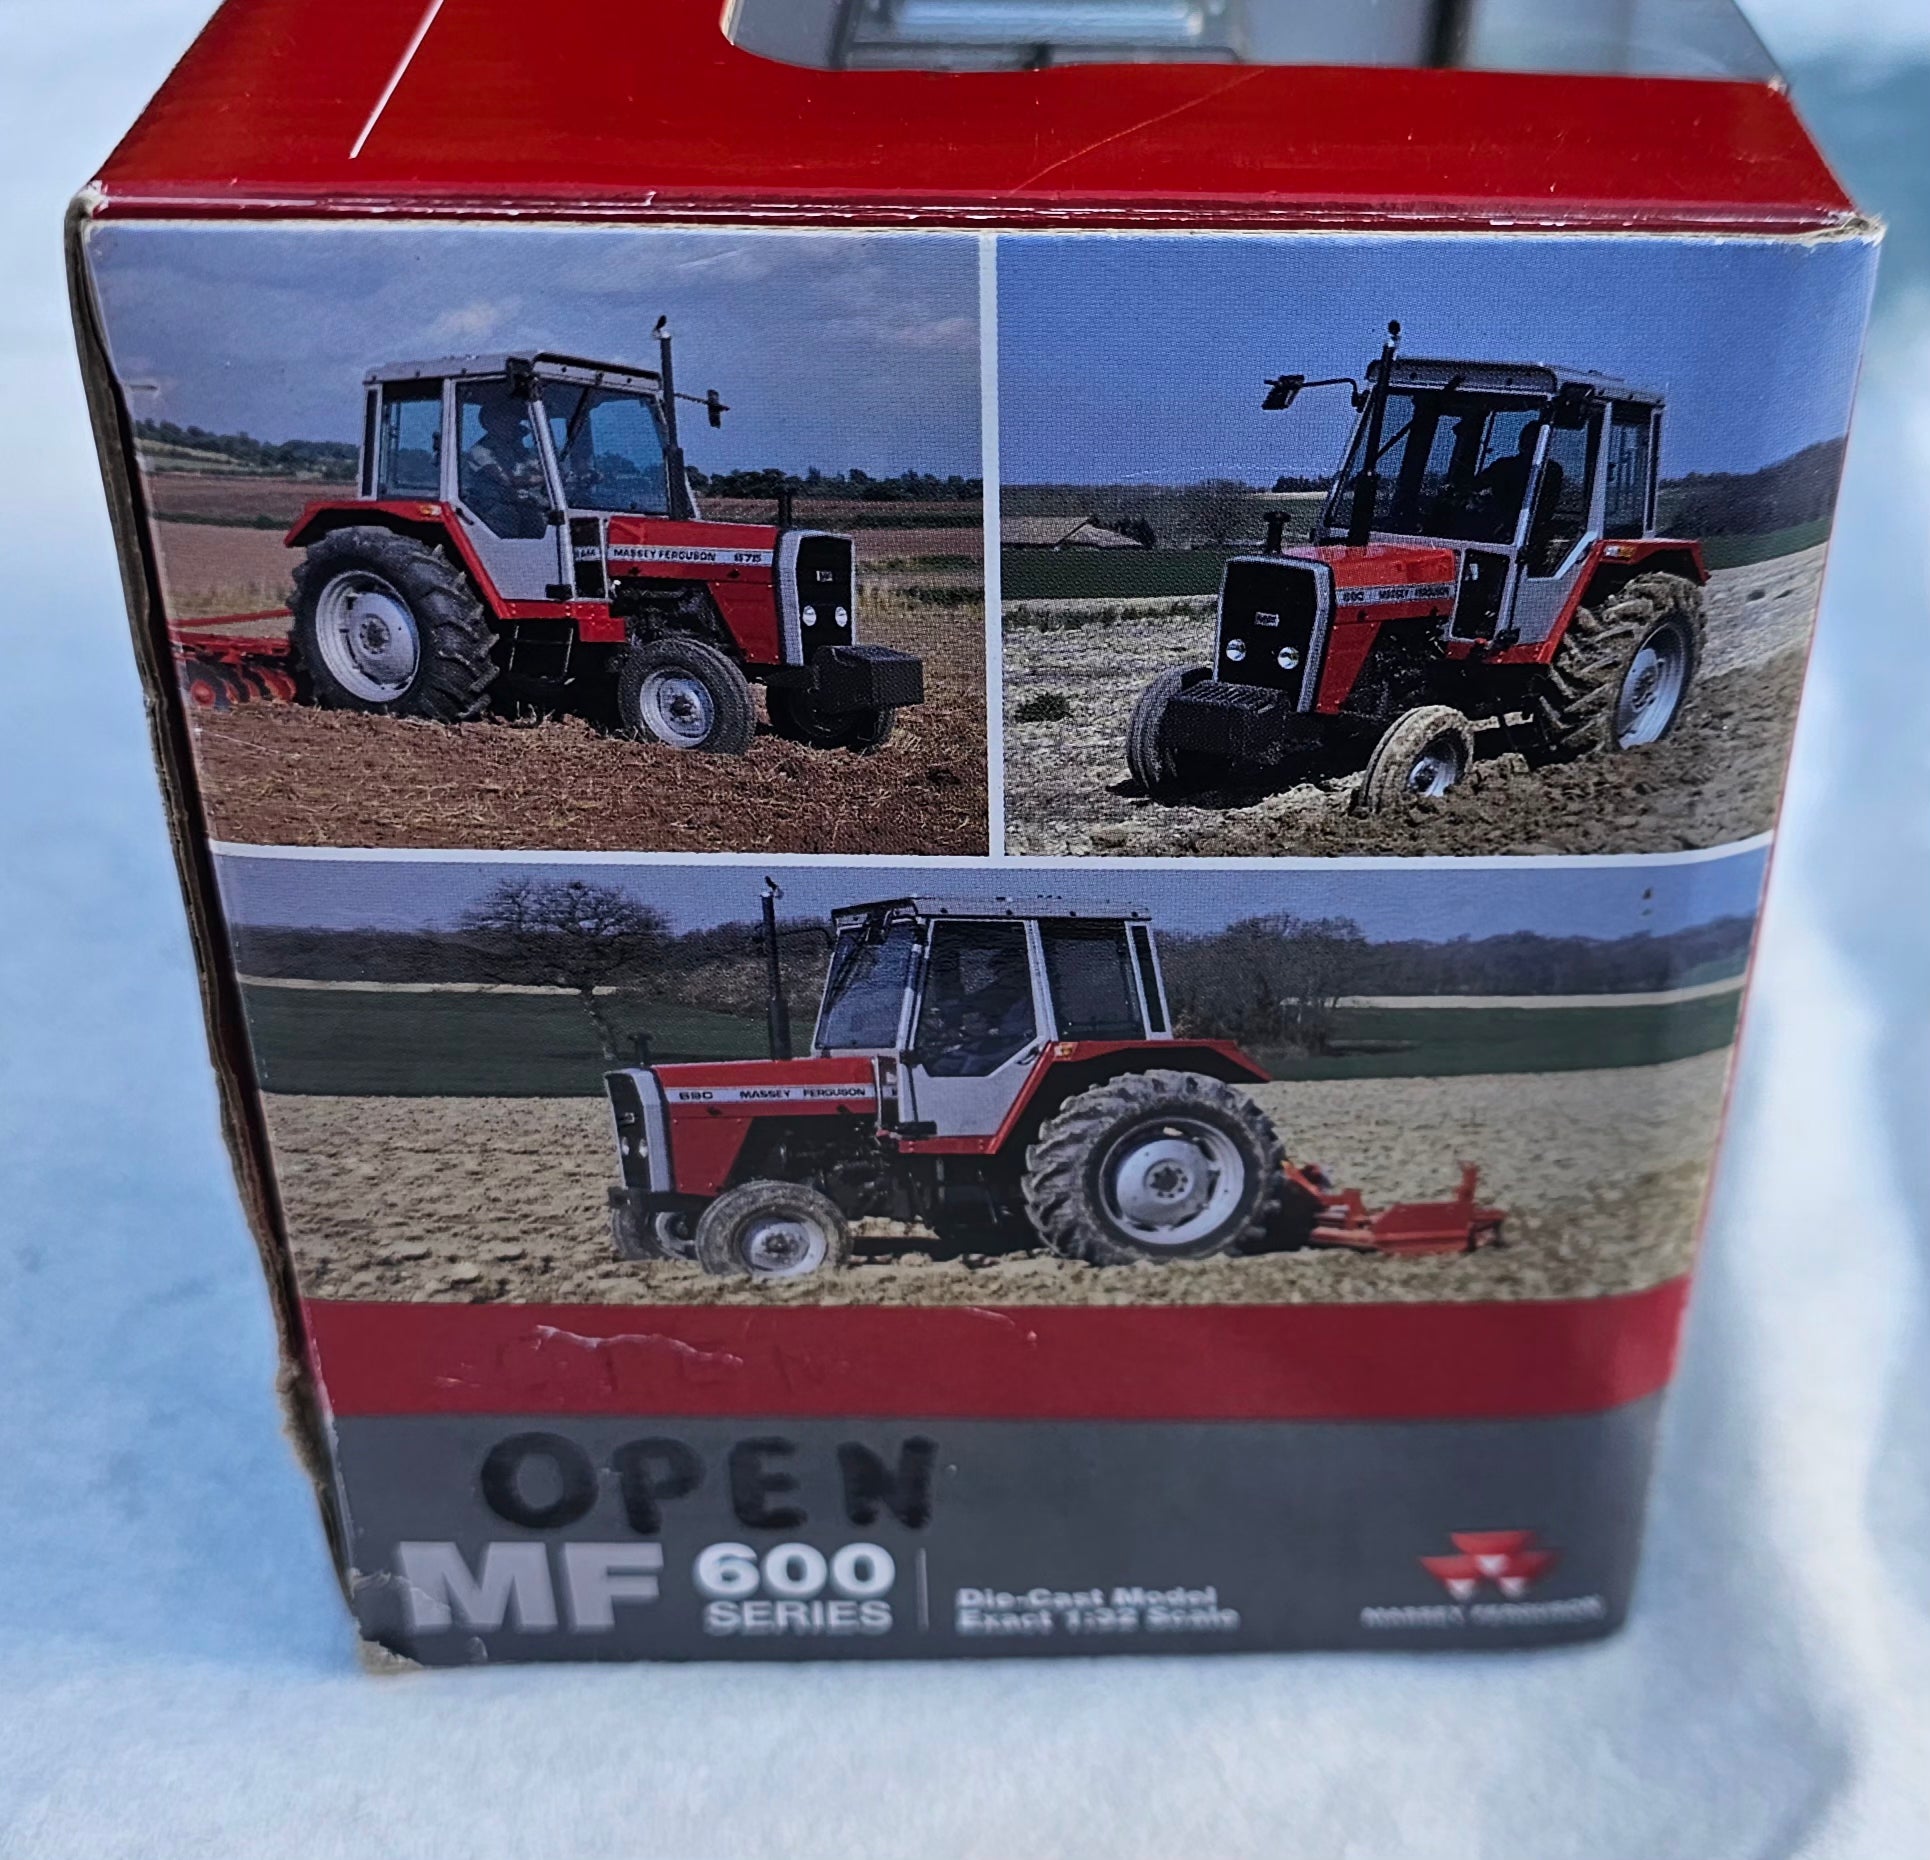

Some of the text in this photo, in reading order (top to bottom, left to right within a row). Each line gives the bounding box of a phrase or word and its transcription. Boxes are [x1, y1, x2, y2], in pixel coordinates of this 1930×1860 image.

[613, 548, 656, 559] MASSEY
[658, 549, 717, 562] FERGUSON
[739, 1089, 791, 1099] MASSEY
[802, 1087, 866, 1098] FERGUSON
[479, 1431, 940, 1535] OPEN
[398, 1540, 898, 1635] MF 600
[1109, 1585, 1214, 1608] Model
[704, 1600, 895, 1637] SERIES
